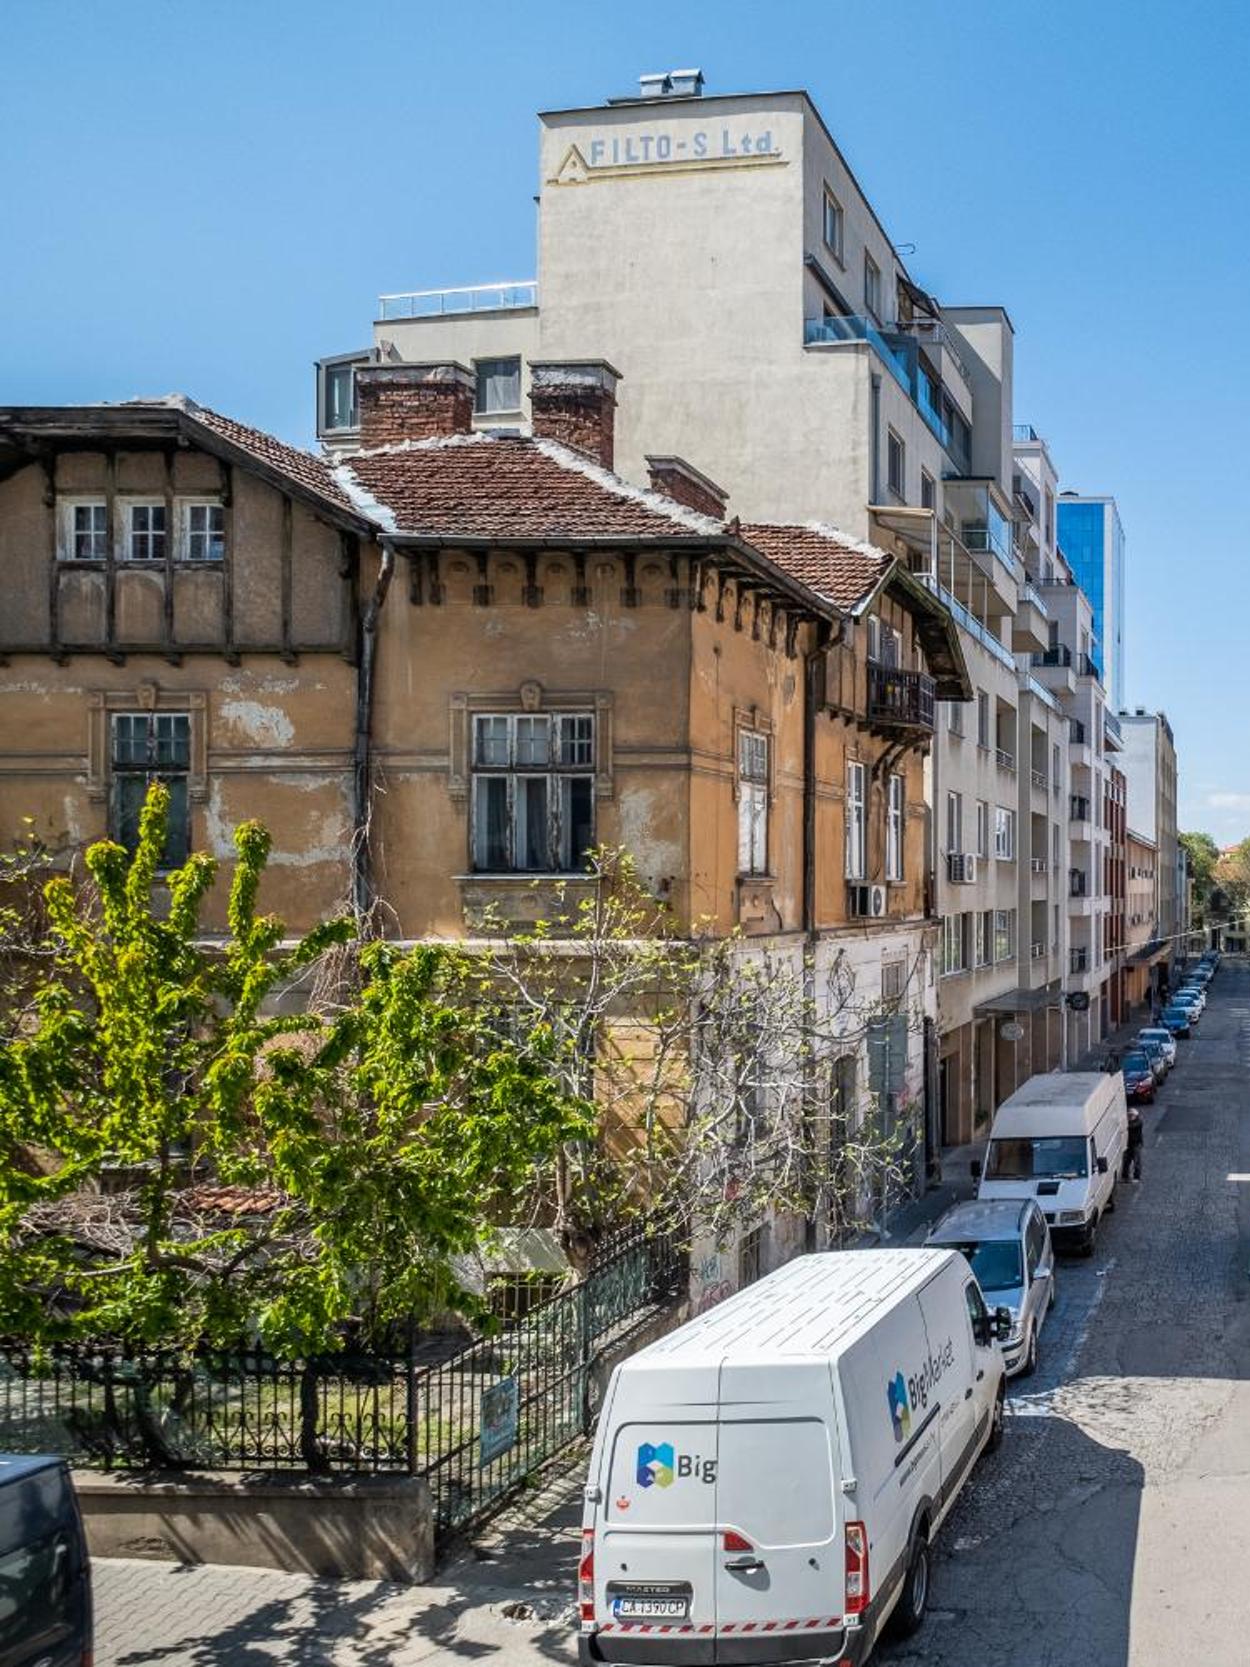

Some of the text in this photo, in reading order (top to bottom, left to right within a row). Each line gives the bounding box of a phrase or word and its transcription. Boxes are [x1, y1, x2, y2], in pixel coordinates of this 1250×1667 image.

[590, 129, 780, 165] FILTO-S Ltd.
[678, 1454, 719, 1484] Big
